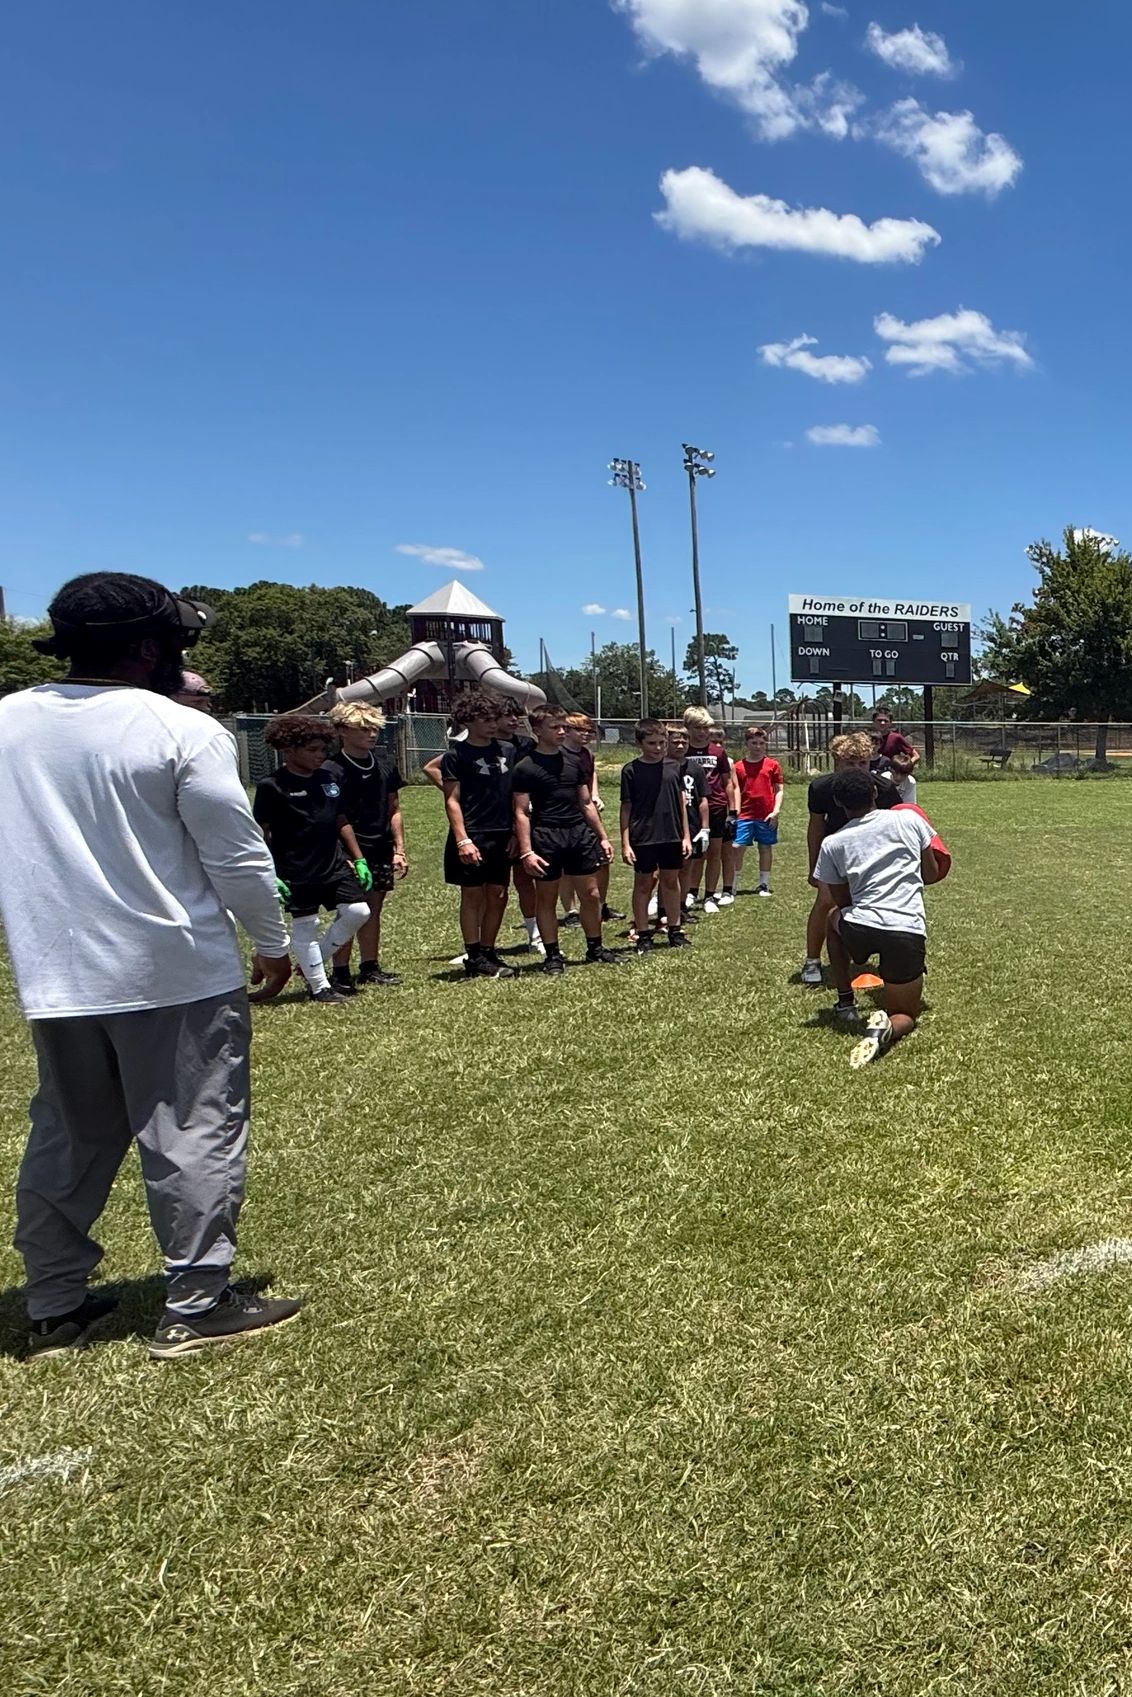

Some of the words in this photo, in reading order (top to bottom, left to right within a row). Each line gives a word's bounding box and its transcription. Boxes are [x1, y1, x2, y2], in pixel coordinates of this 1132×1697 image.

[802, 598, 844, 612] Home
[849, 602, 865, 613] of
[868, 602, 890, 615] the
[894, 603, 959, 618] RAIDERS
[797, 615, 829, 626] HOME
[933, 622, 965, 632] GUEST
[798, 647, 830, 657] DOWN
[869, 649, 882, 658] TO
[884, 650, 899, 659] GO
[940, 652, 959, 662] QTR
